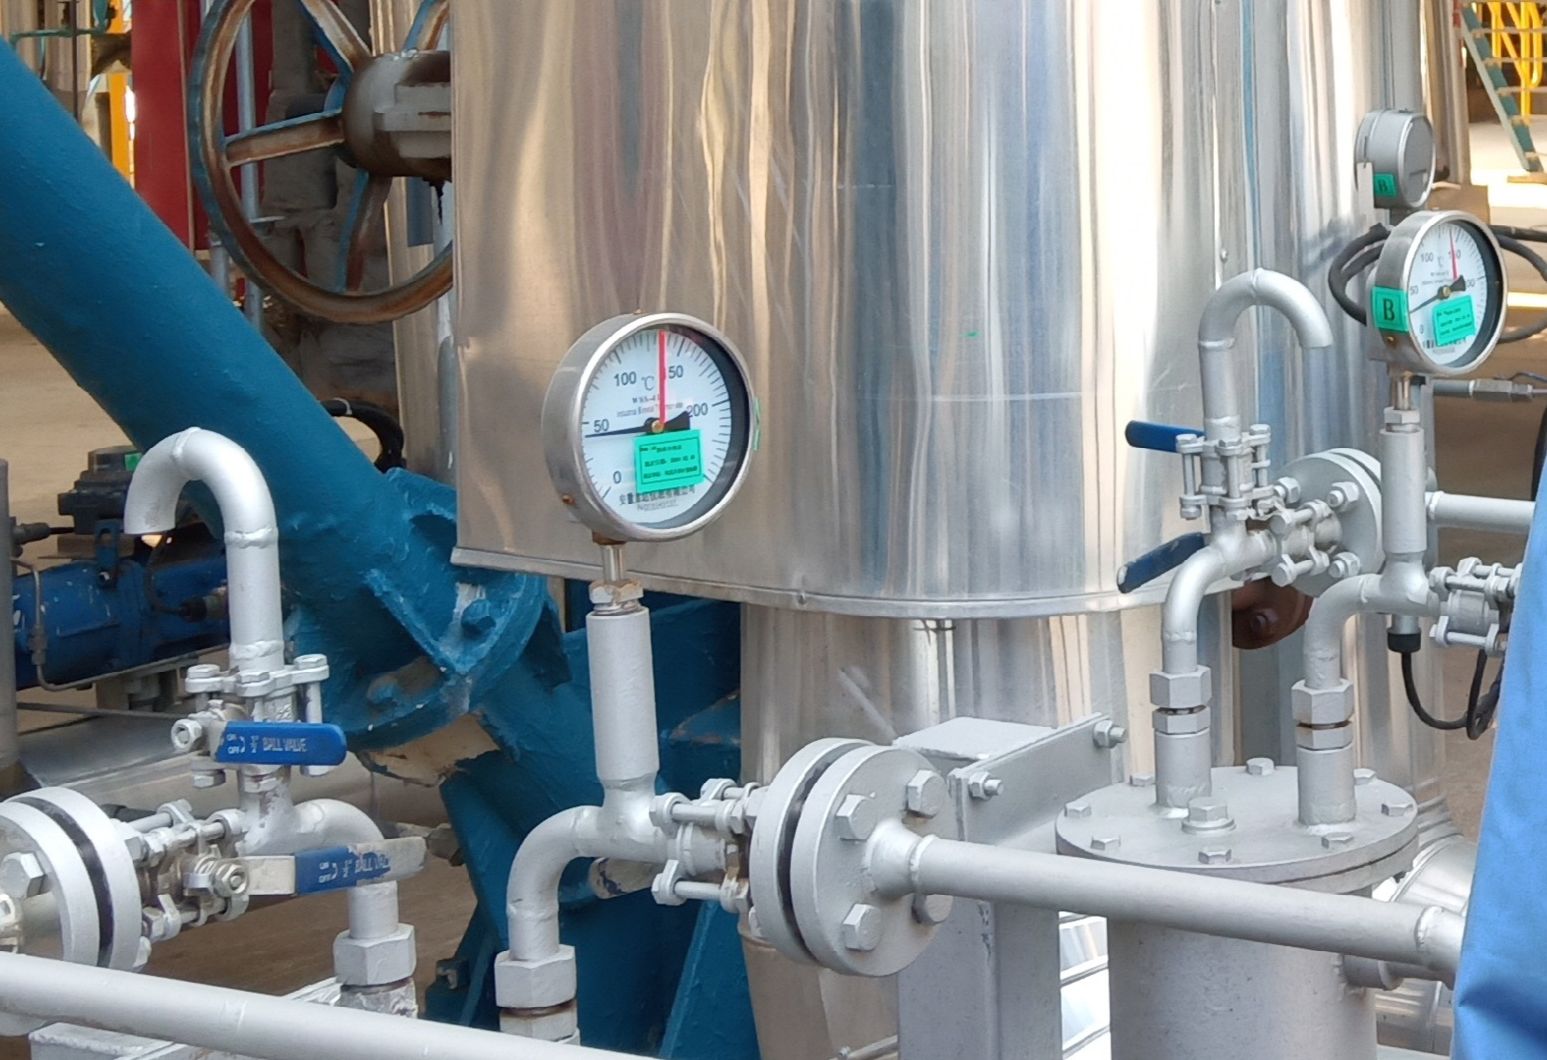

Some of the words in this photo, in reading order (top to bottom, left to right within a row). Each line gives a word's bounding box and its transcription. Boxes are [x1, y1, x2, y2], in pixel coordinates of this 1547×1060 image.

[1383, 298, 1395, 321] B
[614, 371, 637, 387] 100
[667, 364, 684, 380] 50
[686, 402, 708, 419] 200
[594, 419, 609, 433] 50
[613, 470, 622, 484] 0
[262, 737, 283, 751] BALL
[284, 738, 308, 752] VALVE
